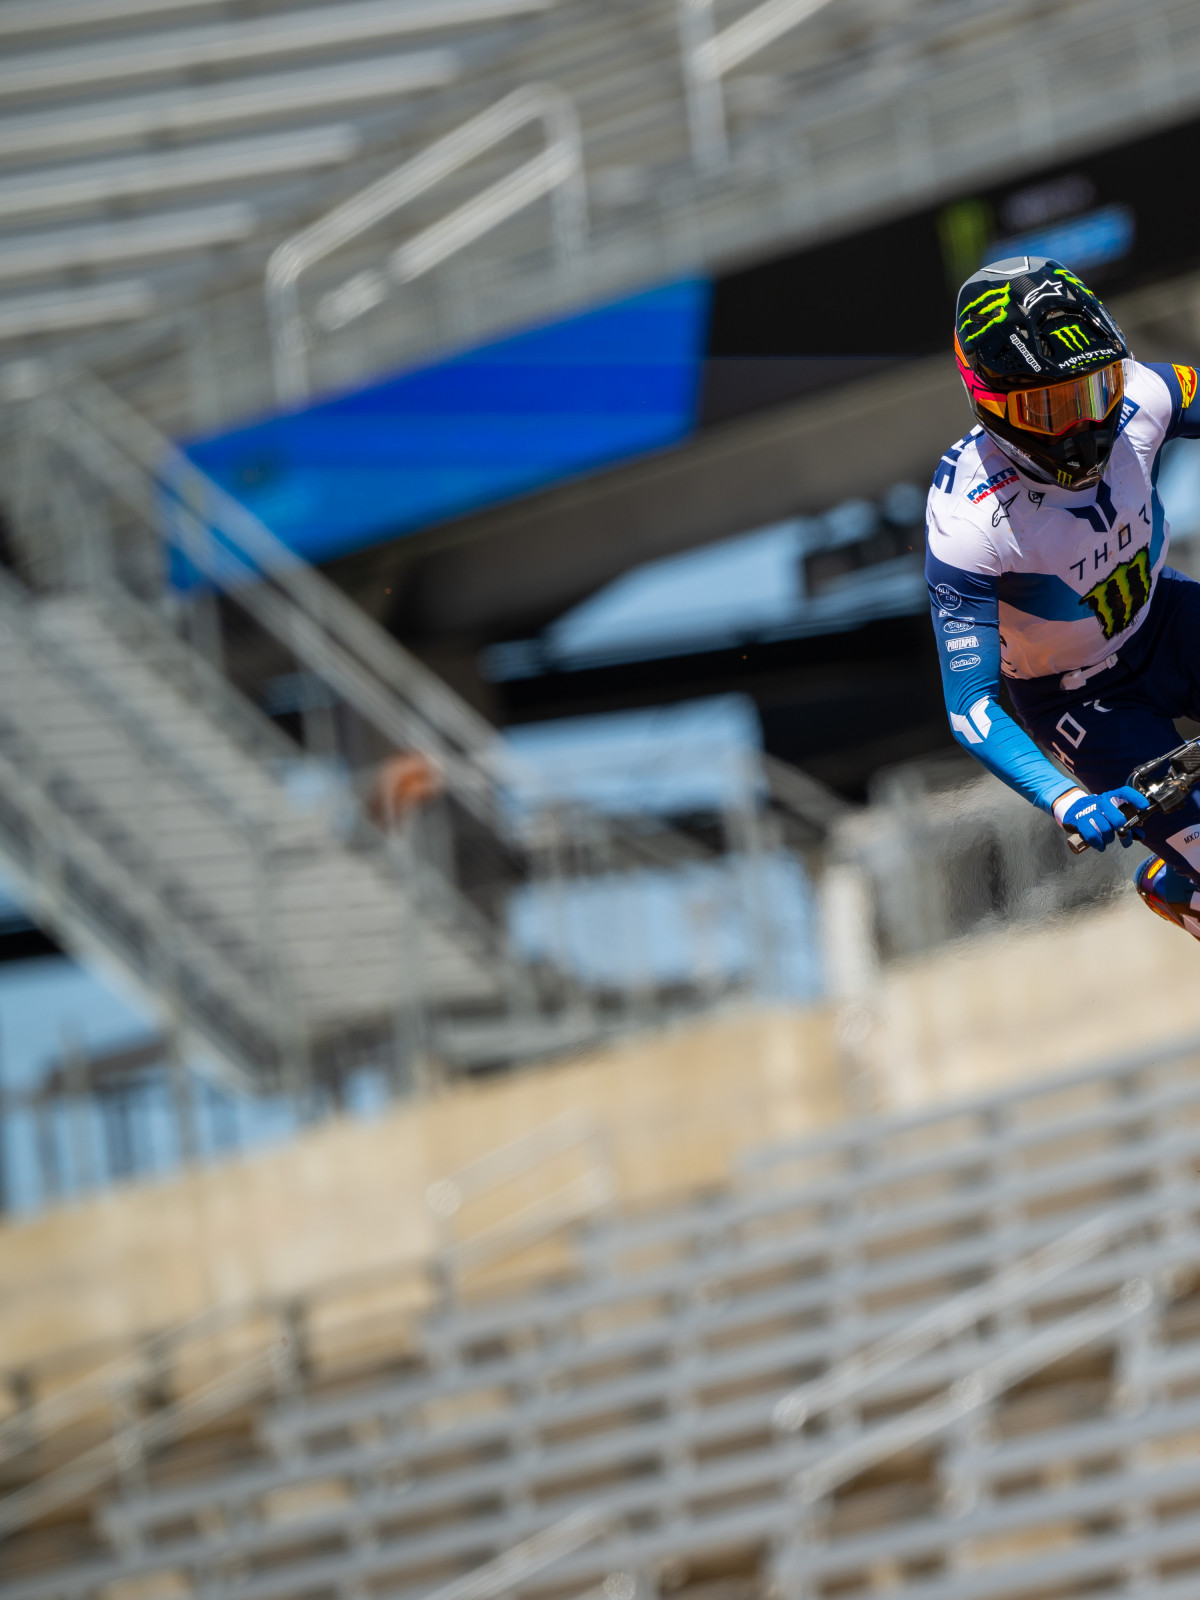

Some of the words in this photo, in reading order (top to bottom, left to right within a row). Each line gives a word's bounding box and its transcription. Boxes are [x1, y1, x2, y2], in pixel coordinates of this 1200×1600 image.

[1009, 334, 1041, 372] apdesigns
[1059, 348, 1116, 370] MONSTER
[1071, 355, 1111, 369] ENERGY
[967, 467, 1017, 501] PARTS
[1075, 804, 1097, 820] THOR
